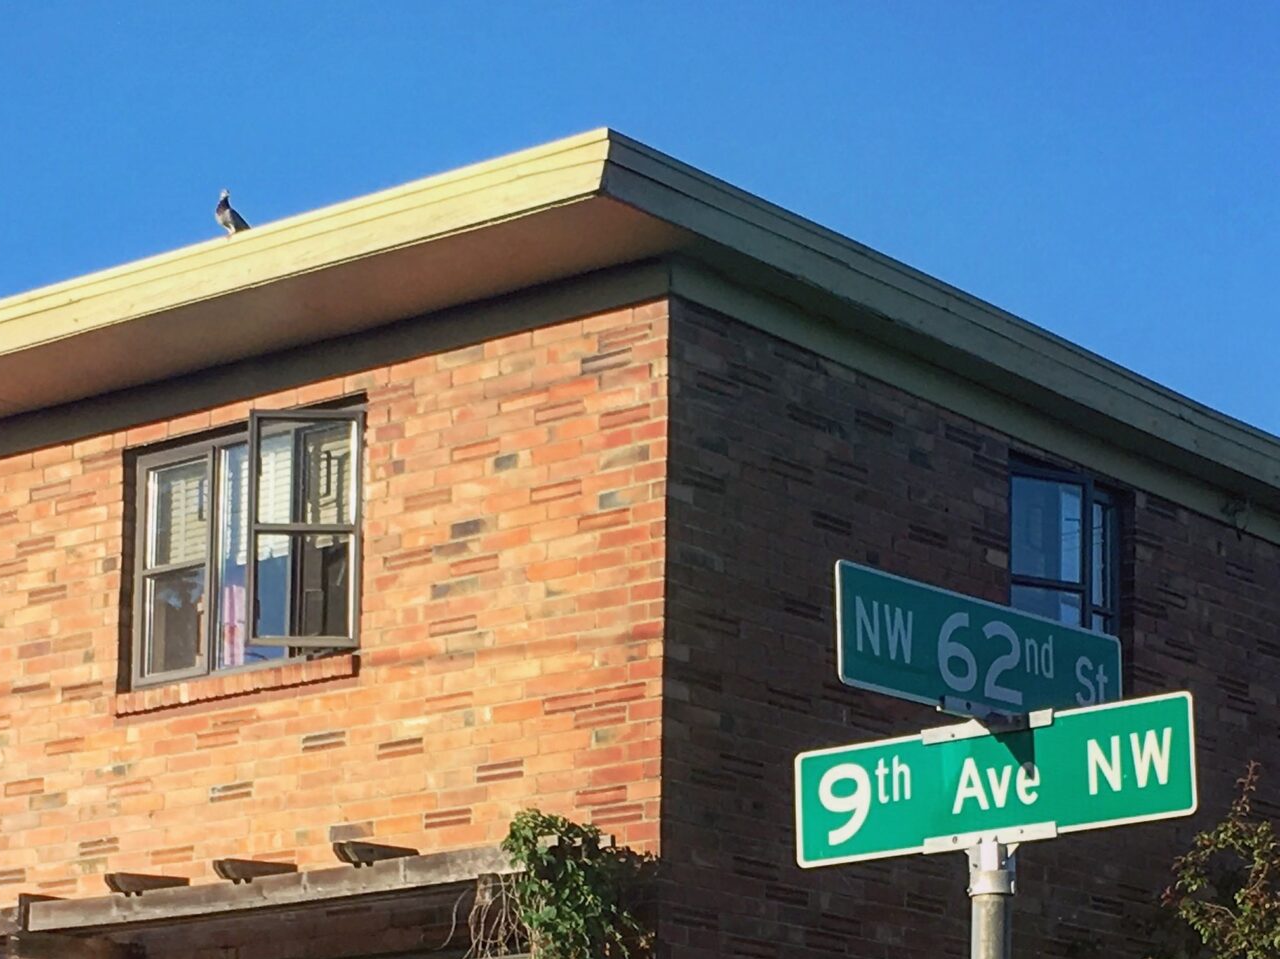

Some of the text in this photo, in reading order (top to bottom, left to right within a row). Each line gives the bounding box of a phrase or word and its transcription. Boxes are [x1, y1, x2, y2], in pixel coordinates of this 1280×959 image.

[854, 596, 1109, 706] NW 62nd St
[819, 727, 1172, 846] 9th Ave NW
